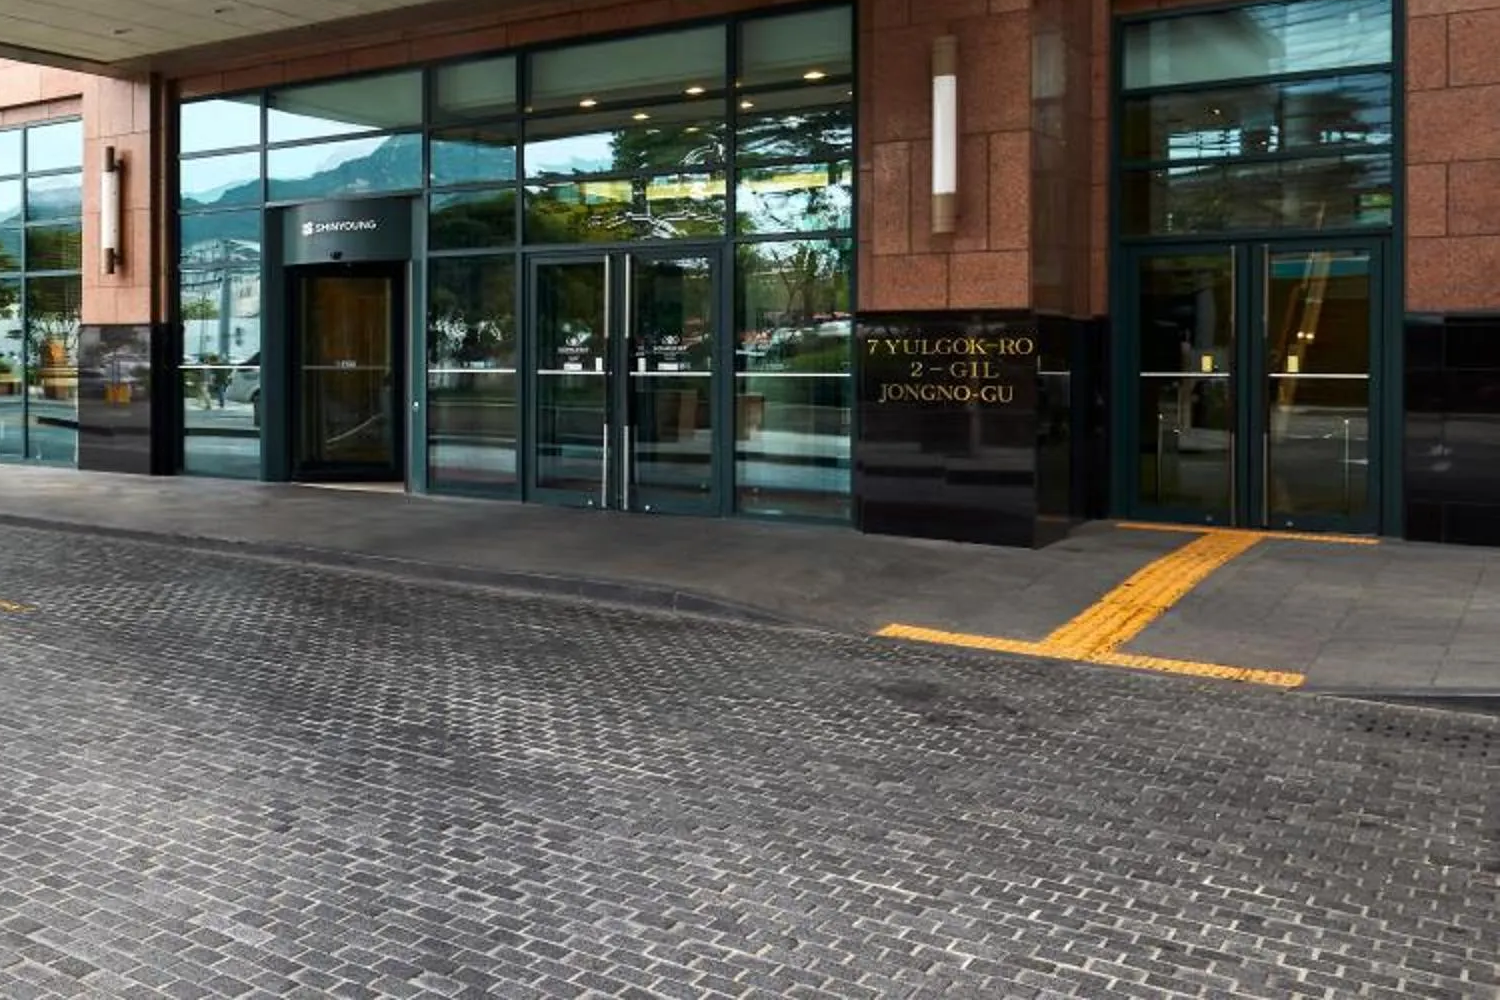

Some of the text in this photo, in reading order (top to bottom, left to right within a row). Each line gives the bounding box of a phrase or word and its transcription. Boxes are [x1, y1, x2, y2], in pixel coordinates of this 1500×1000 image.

[315, 219, 377, 232] SHINYOUNG
[867, 338, 1034, 355] 7 YULGOK-RO
[879, 384, 1013, 403] JONGNO-GU
